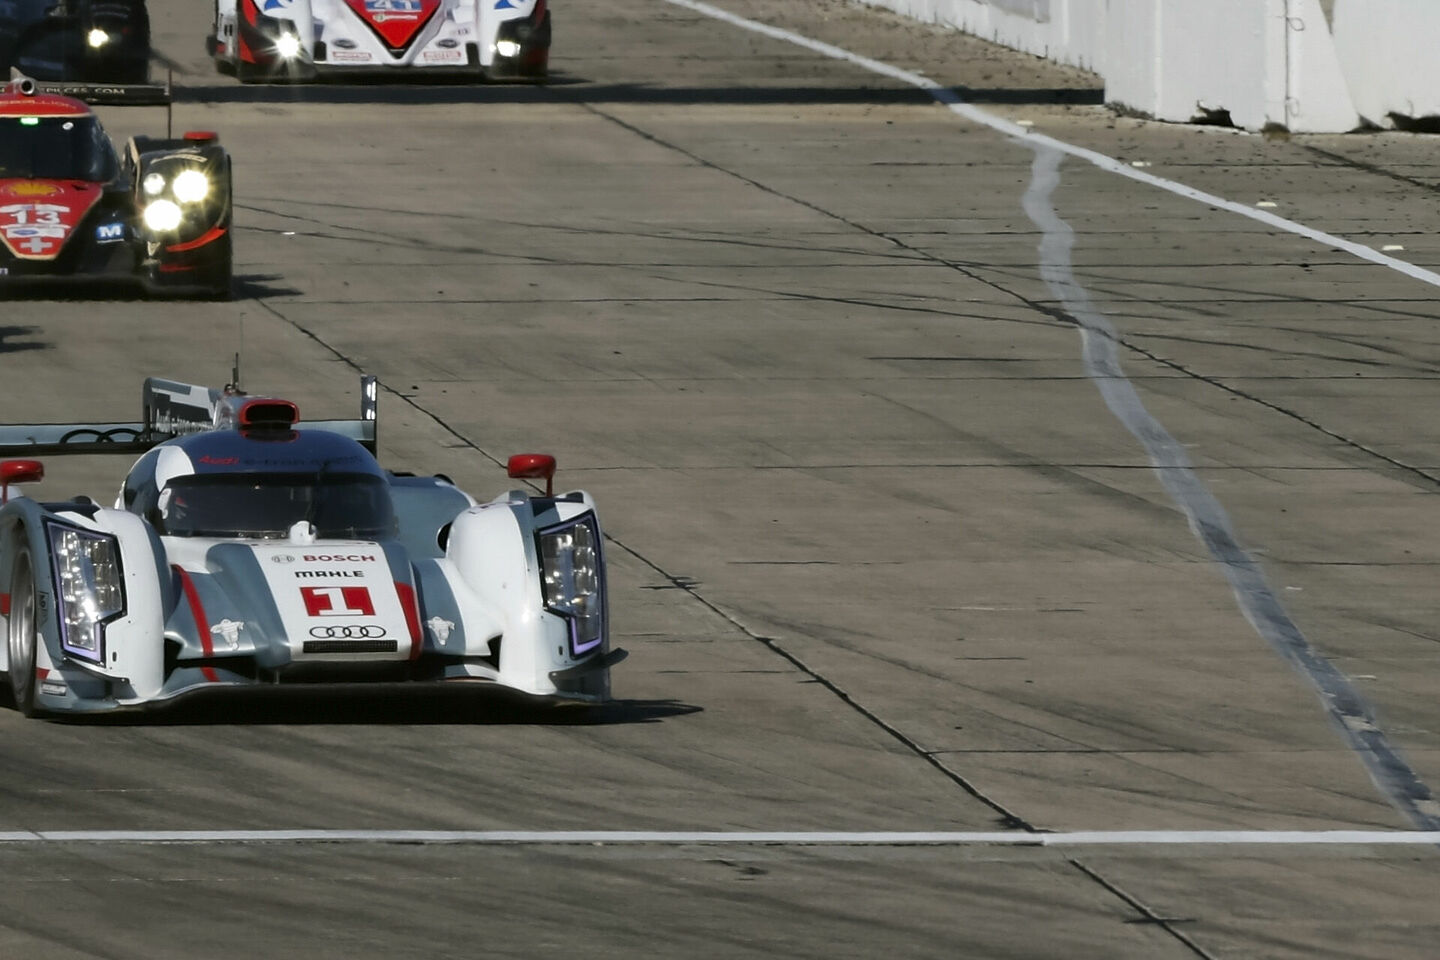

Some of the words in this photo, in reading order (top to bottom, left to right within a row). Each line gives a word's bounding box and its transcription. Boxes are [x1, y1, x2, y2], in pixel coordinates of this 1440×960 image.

[10, 210, 61, 225] 13
[199, 455, 241, 465] Audi
[302, 554, 376, 562] BOSCH
[294, 570, 365, 578] MAHLE
[312, 587, 365, 616] 1
